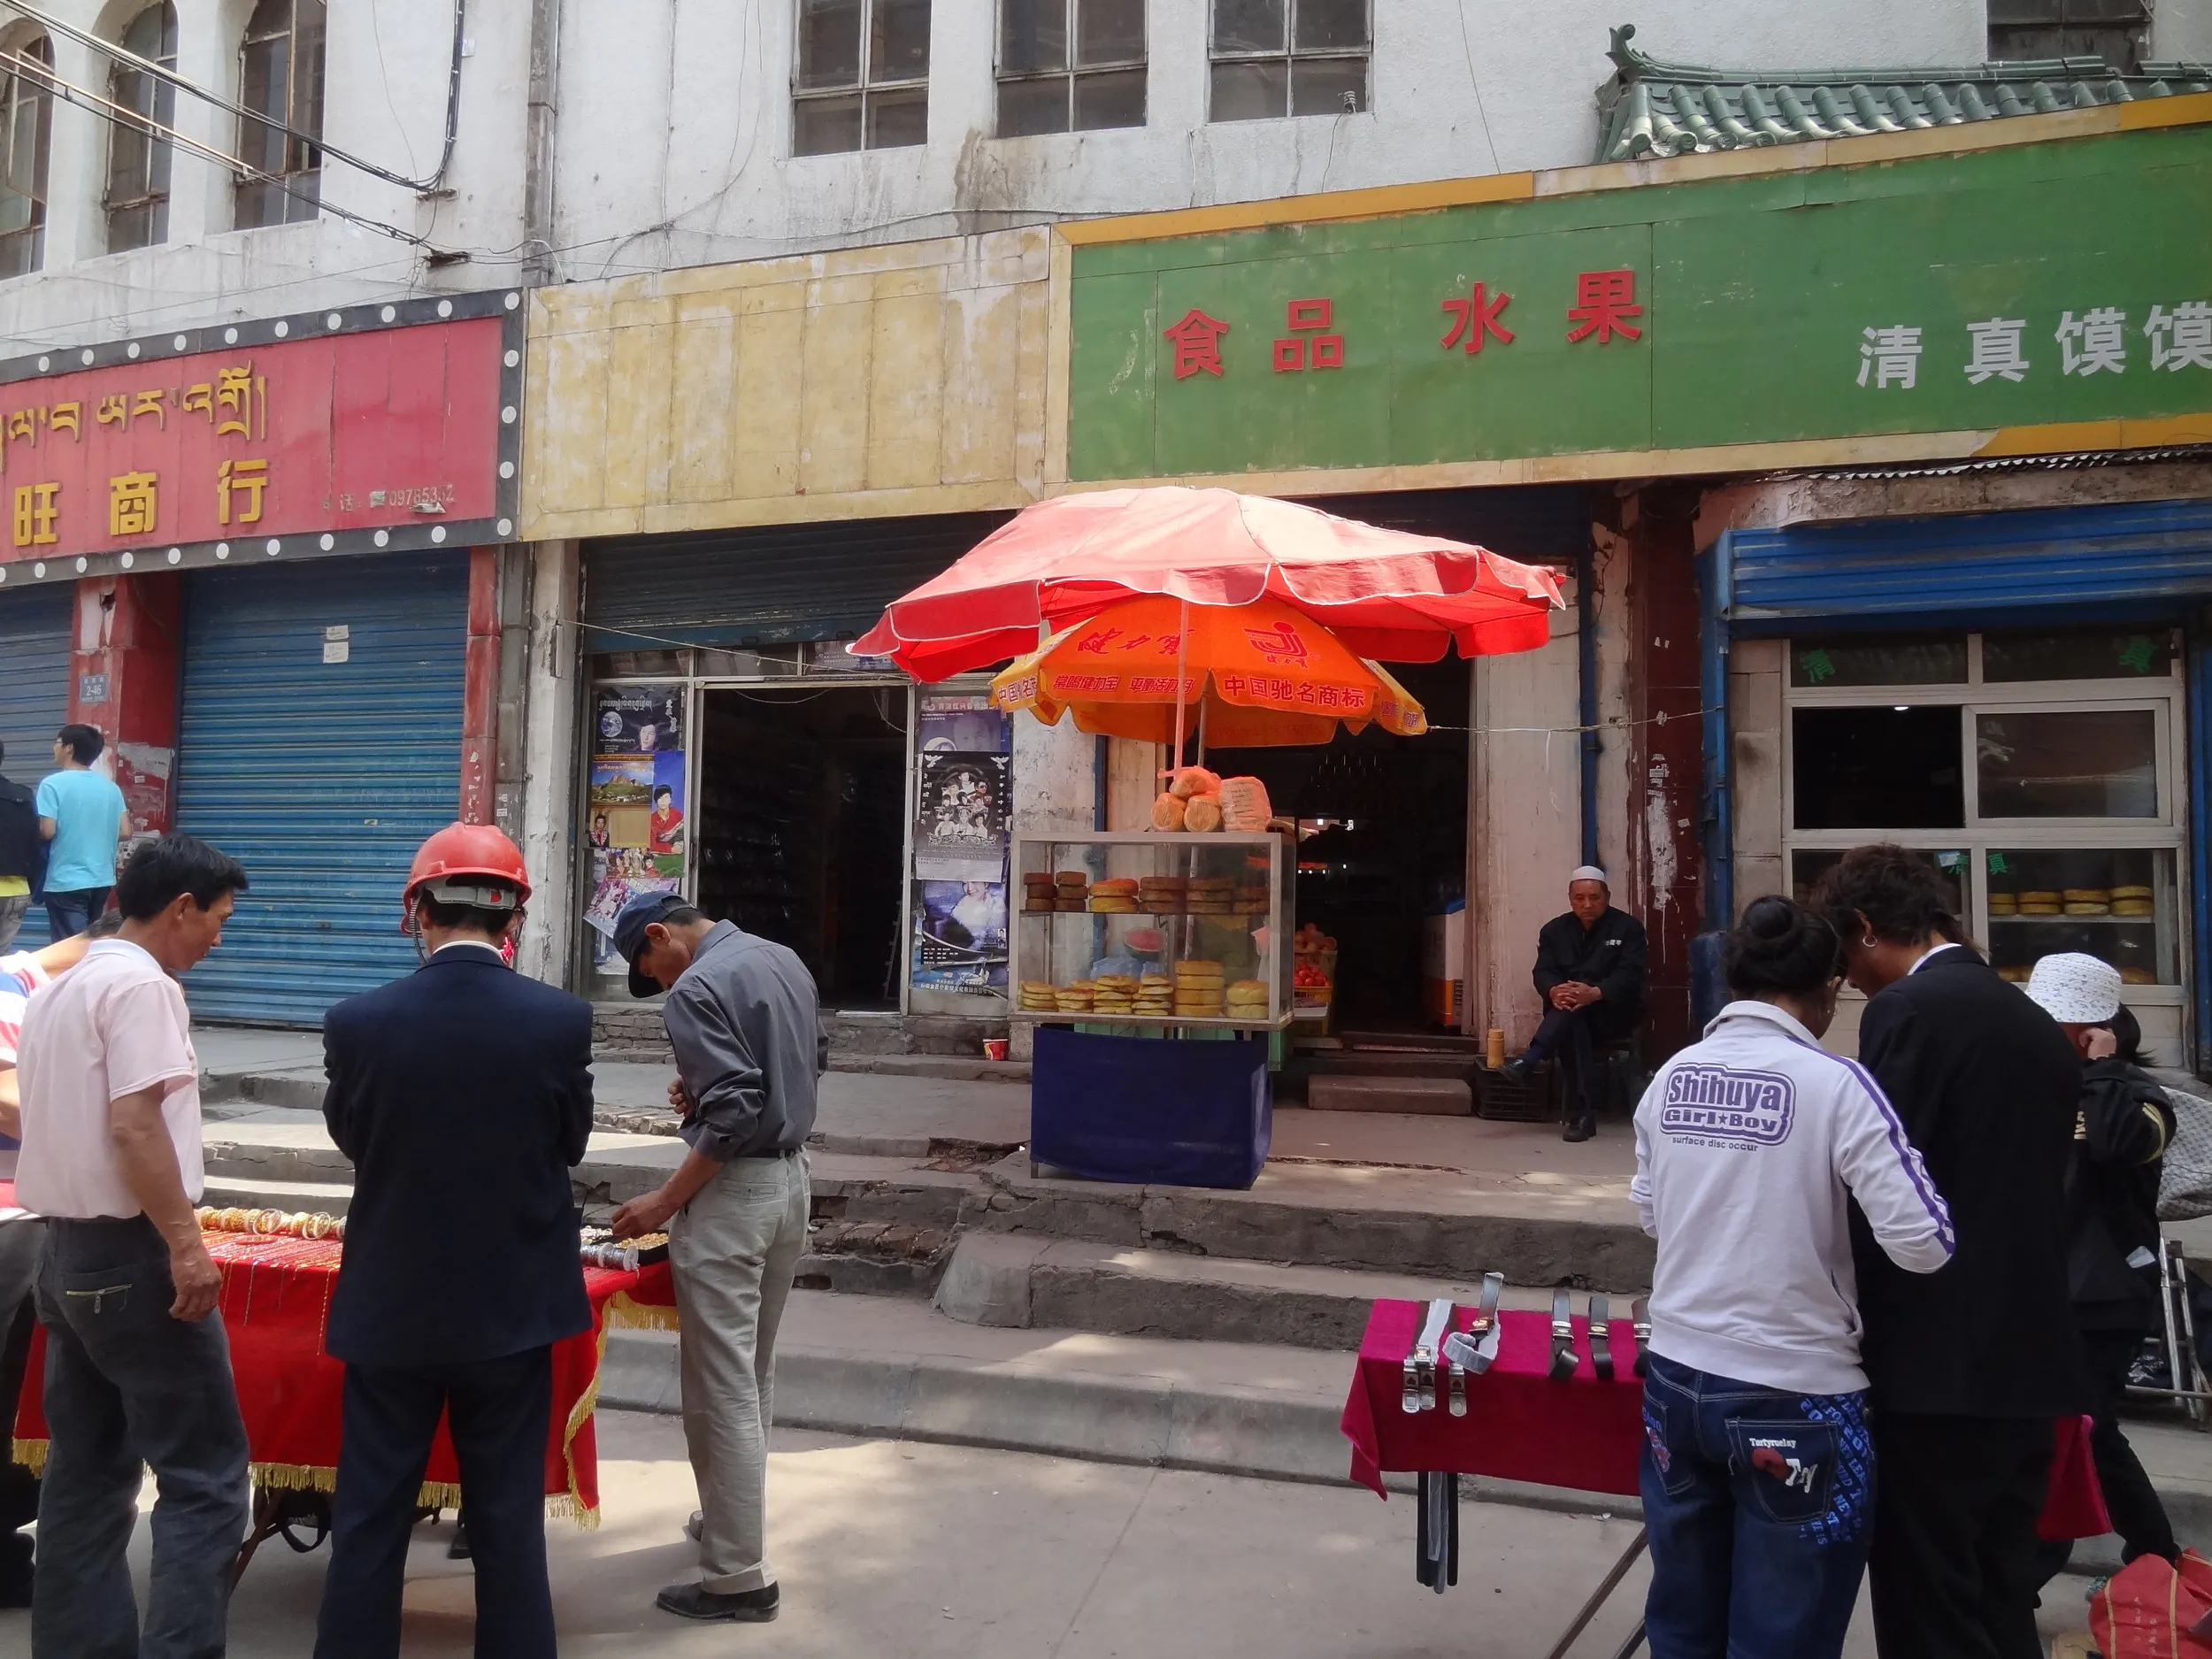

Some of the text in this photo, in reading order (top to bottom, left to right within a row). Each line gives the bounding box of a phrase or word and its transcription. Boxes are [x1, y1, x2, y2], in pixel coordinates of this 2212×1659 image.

[1224, 675, 1365, 708] 中国驰名商标
[1669, 1073, 1782, 1113] Shihuya
[1672, 1136, 1758, 1152] surface disc occur
